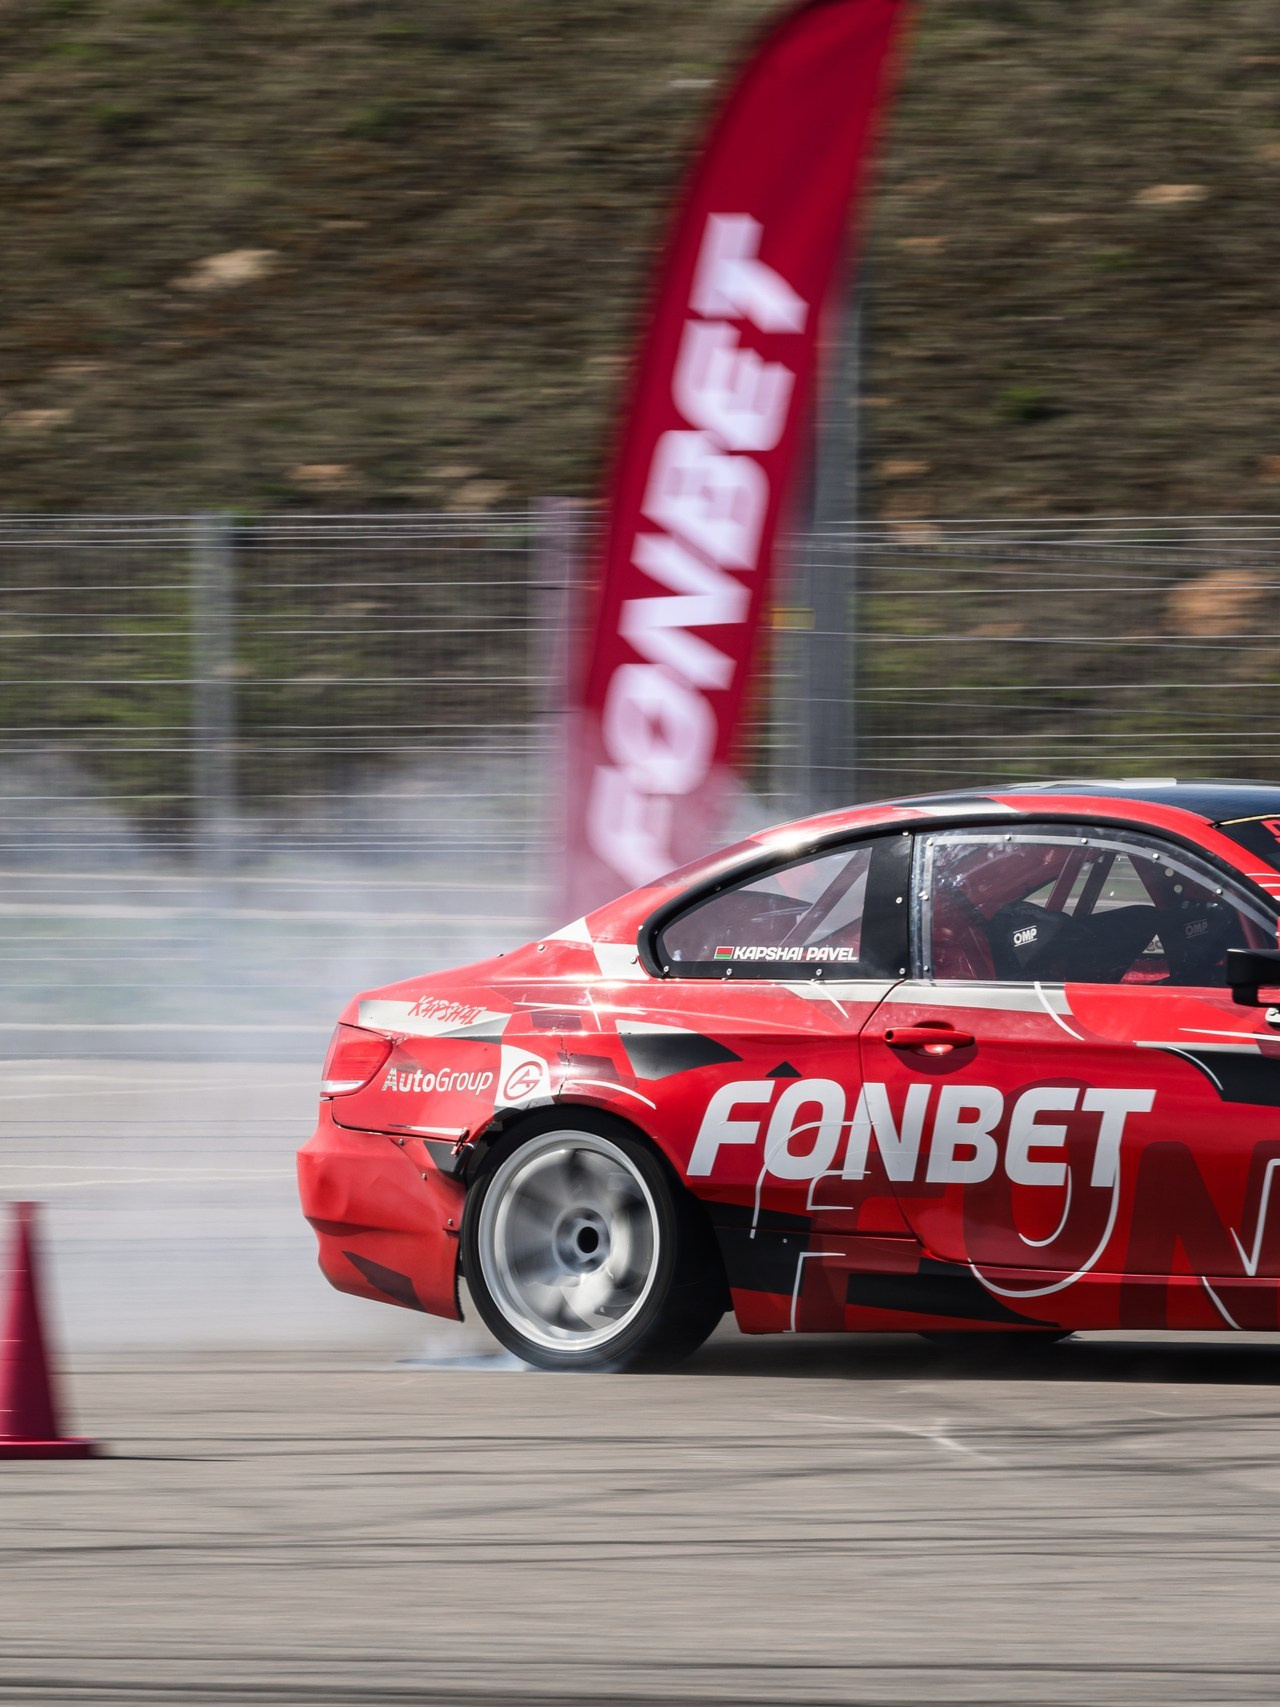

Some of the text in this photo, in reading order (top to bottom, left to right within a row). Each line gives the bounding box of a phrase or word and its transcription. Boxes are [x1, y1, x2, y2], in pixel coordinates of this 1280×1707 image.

[586, 212, 808, 888] FONBET
[1013, 928, 1037, 944] OMP
[733, 946, 858, 961] KAPSHAI PAVEL
[381, 1067, 493, 1095] AutoGroup
[686, 1078, 1157, 1187] FONBET
